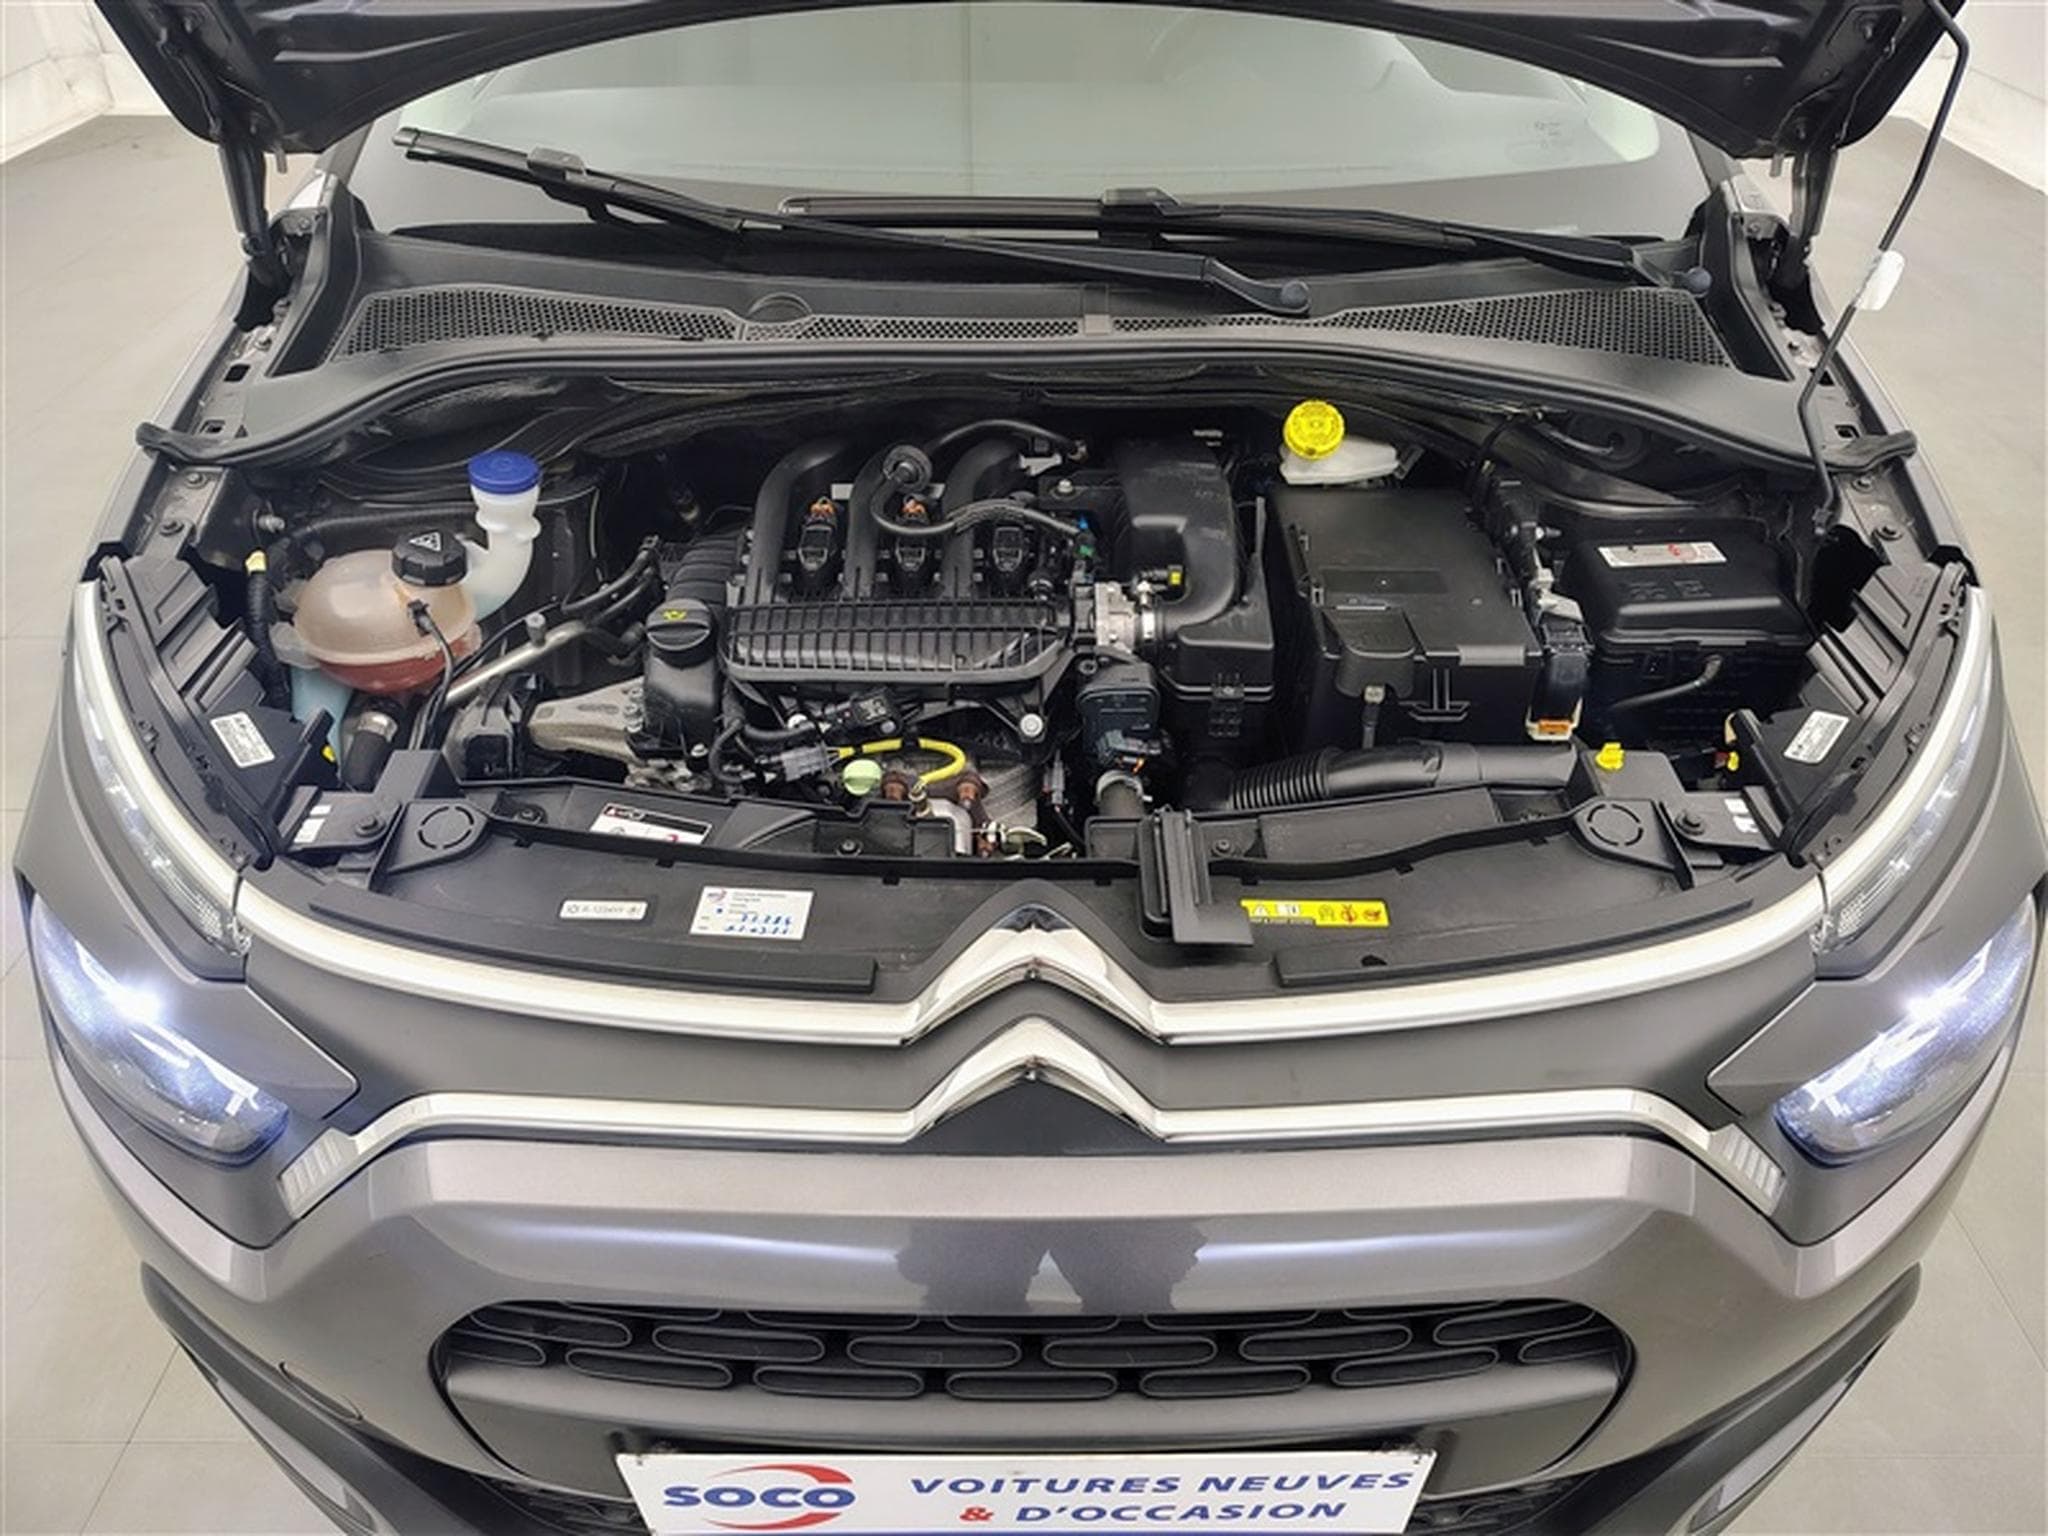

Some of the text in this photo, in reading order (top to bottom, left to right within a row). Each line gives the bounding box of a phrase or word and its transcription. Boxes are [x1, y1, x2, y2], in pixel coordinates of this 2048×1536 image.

[910, 1472, 1414, 1494] VOITURES NEUVES
[662, 1485, 857, 1508] SOCO
[958, 1502, 1347, 1522] & D'OCCASION
